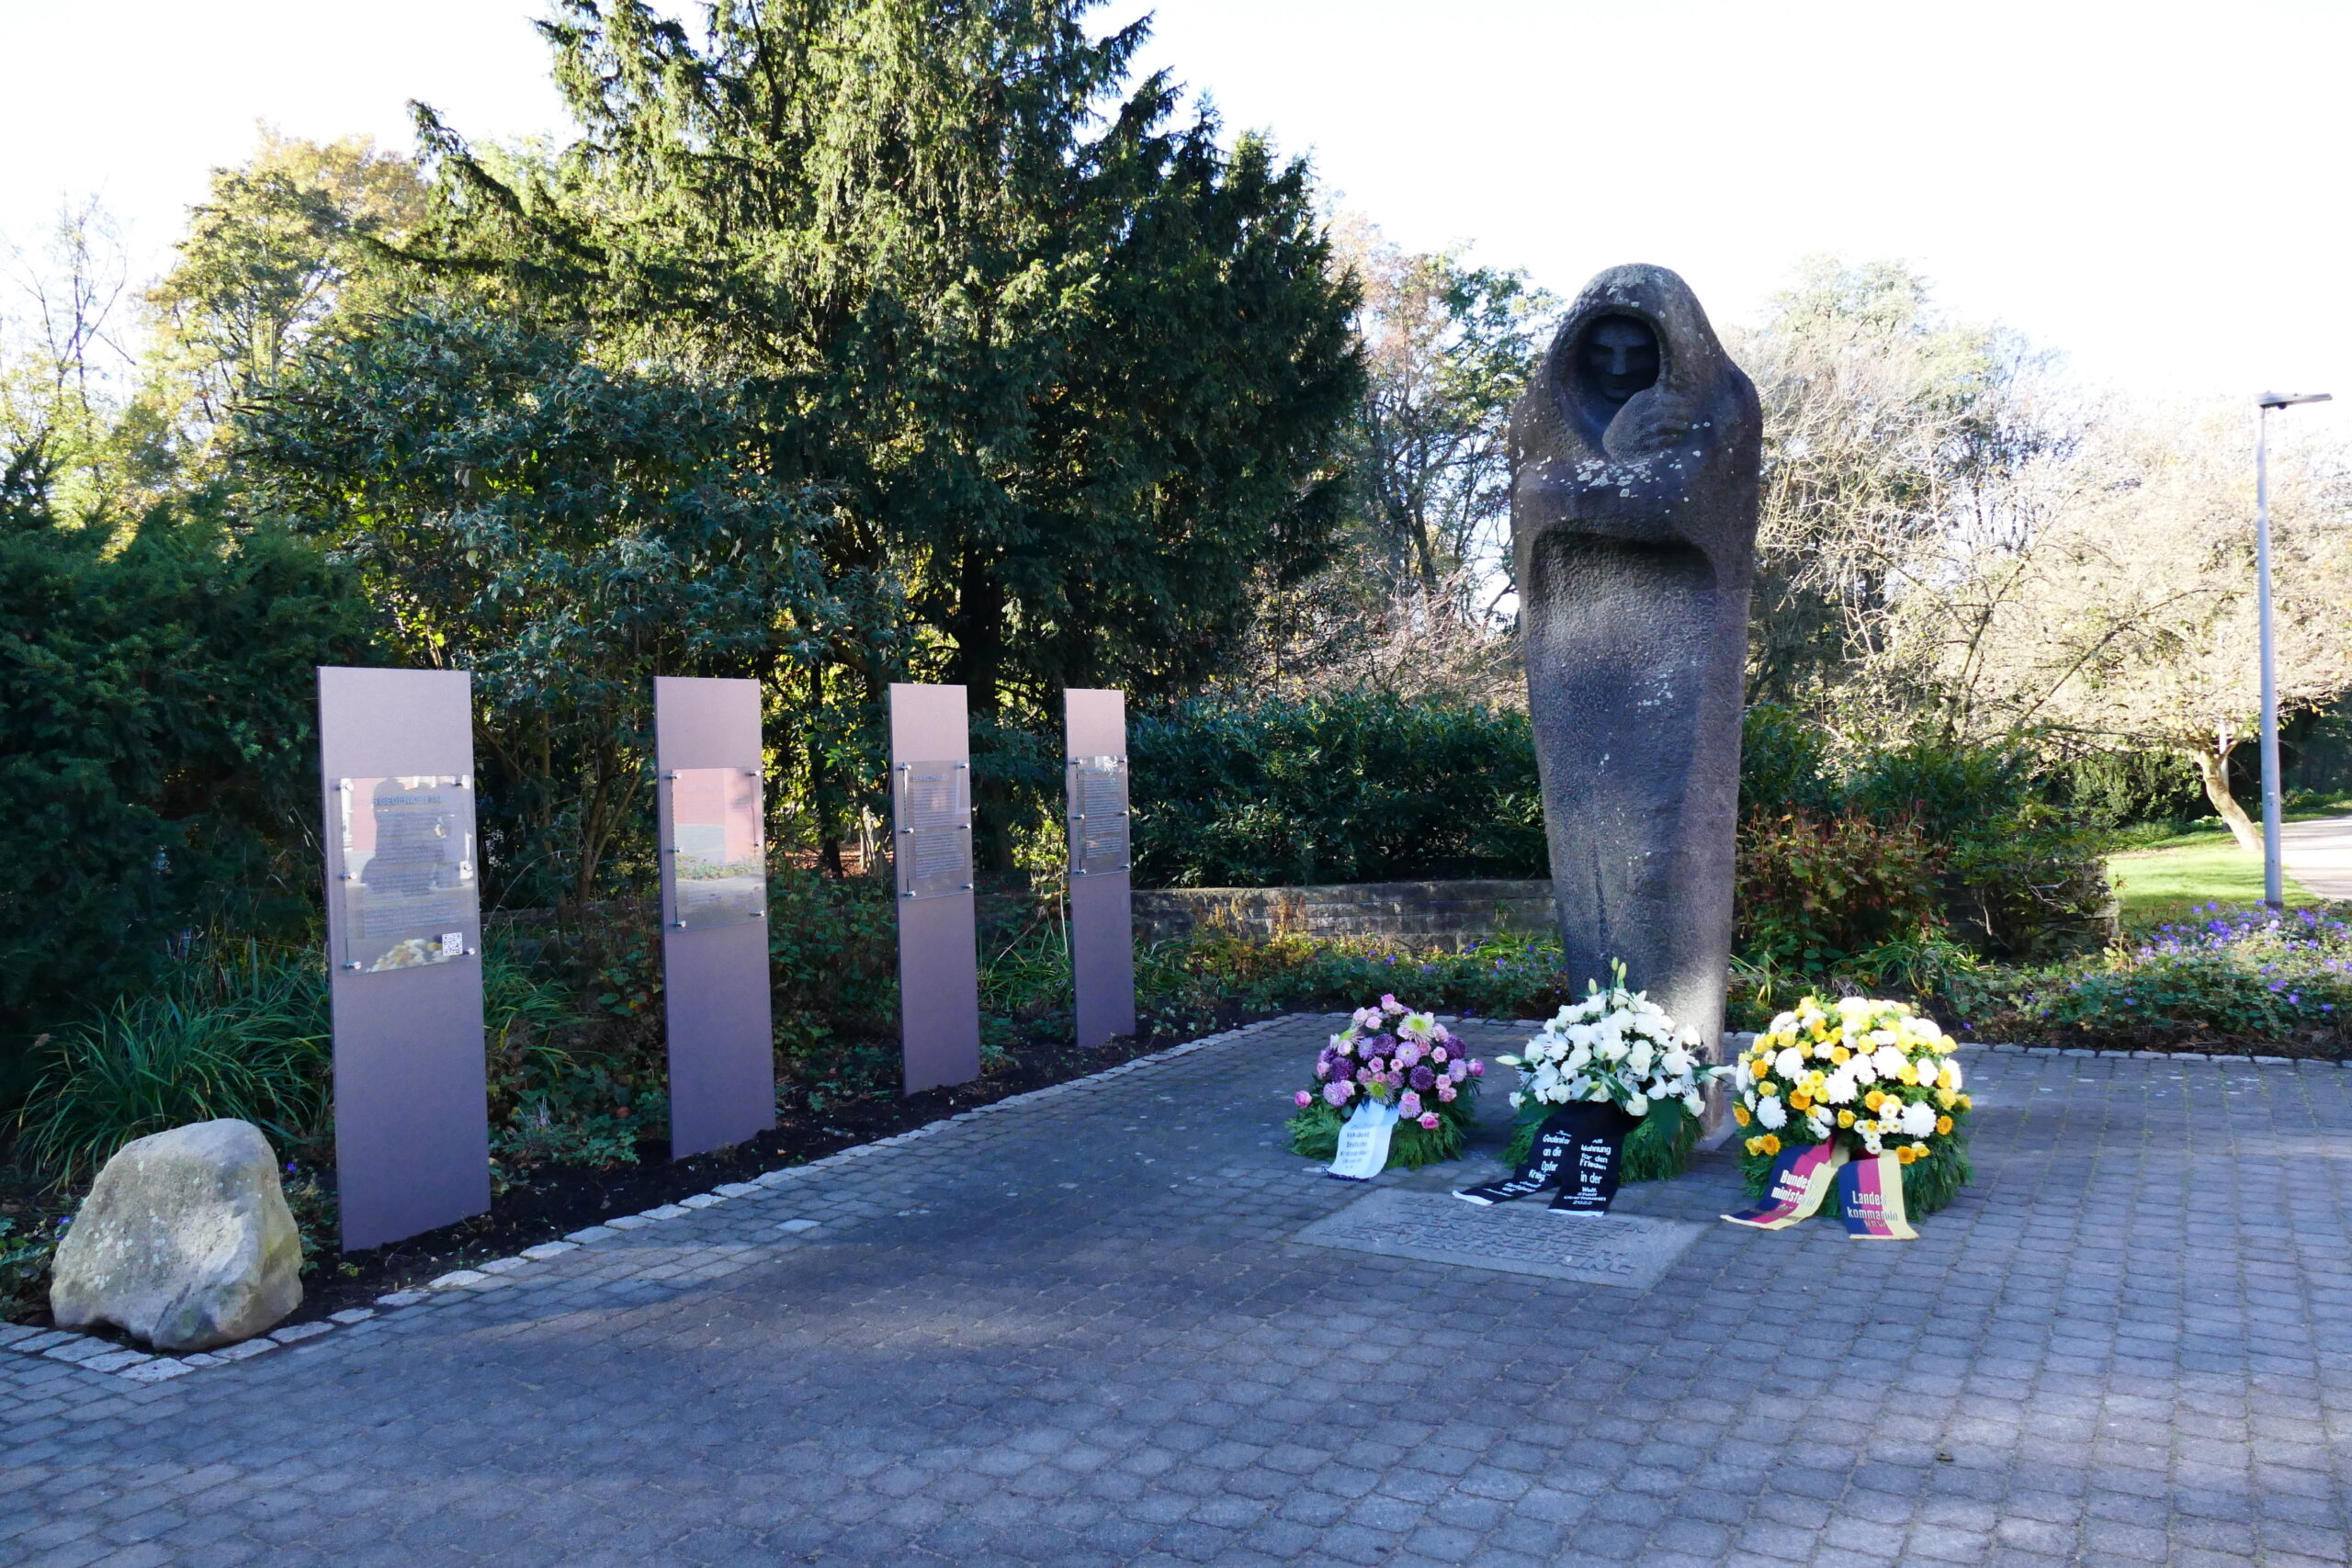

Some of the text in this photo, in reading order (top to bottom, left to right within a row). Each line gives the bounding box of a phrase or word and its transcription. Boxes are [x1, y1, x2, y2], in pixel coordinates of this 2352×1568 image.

[1543, 1145, 1563, 1157] an die
[1580, 1144, 1611, 1156] Mahnung
[1579, 1158, 1607, 1170] Frieden
[1595, 1155, 1609, 1164] den
[1541, 1160, 1559, 1173] Opfer
[1580, 1170, 1603, 1184] in der
[1770, 1185, 1816, 1207] ministerin
[1847, 1205, 1899, 1222] kommando
[1319, 1226, 1637, 1276] DER VERTREIBUNG
